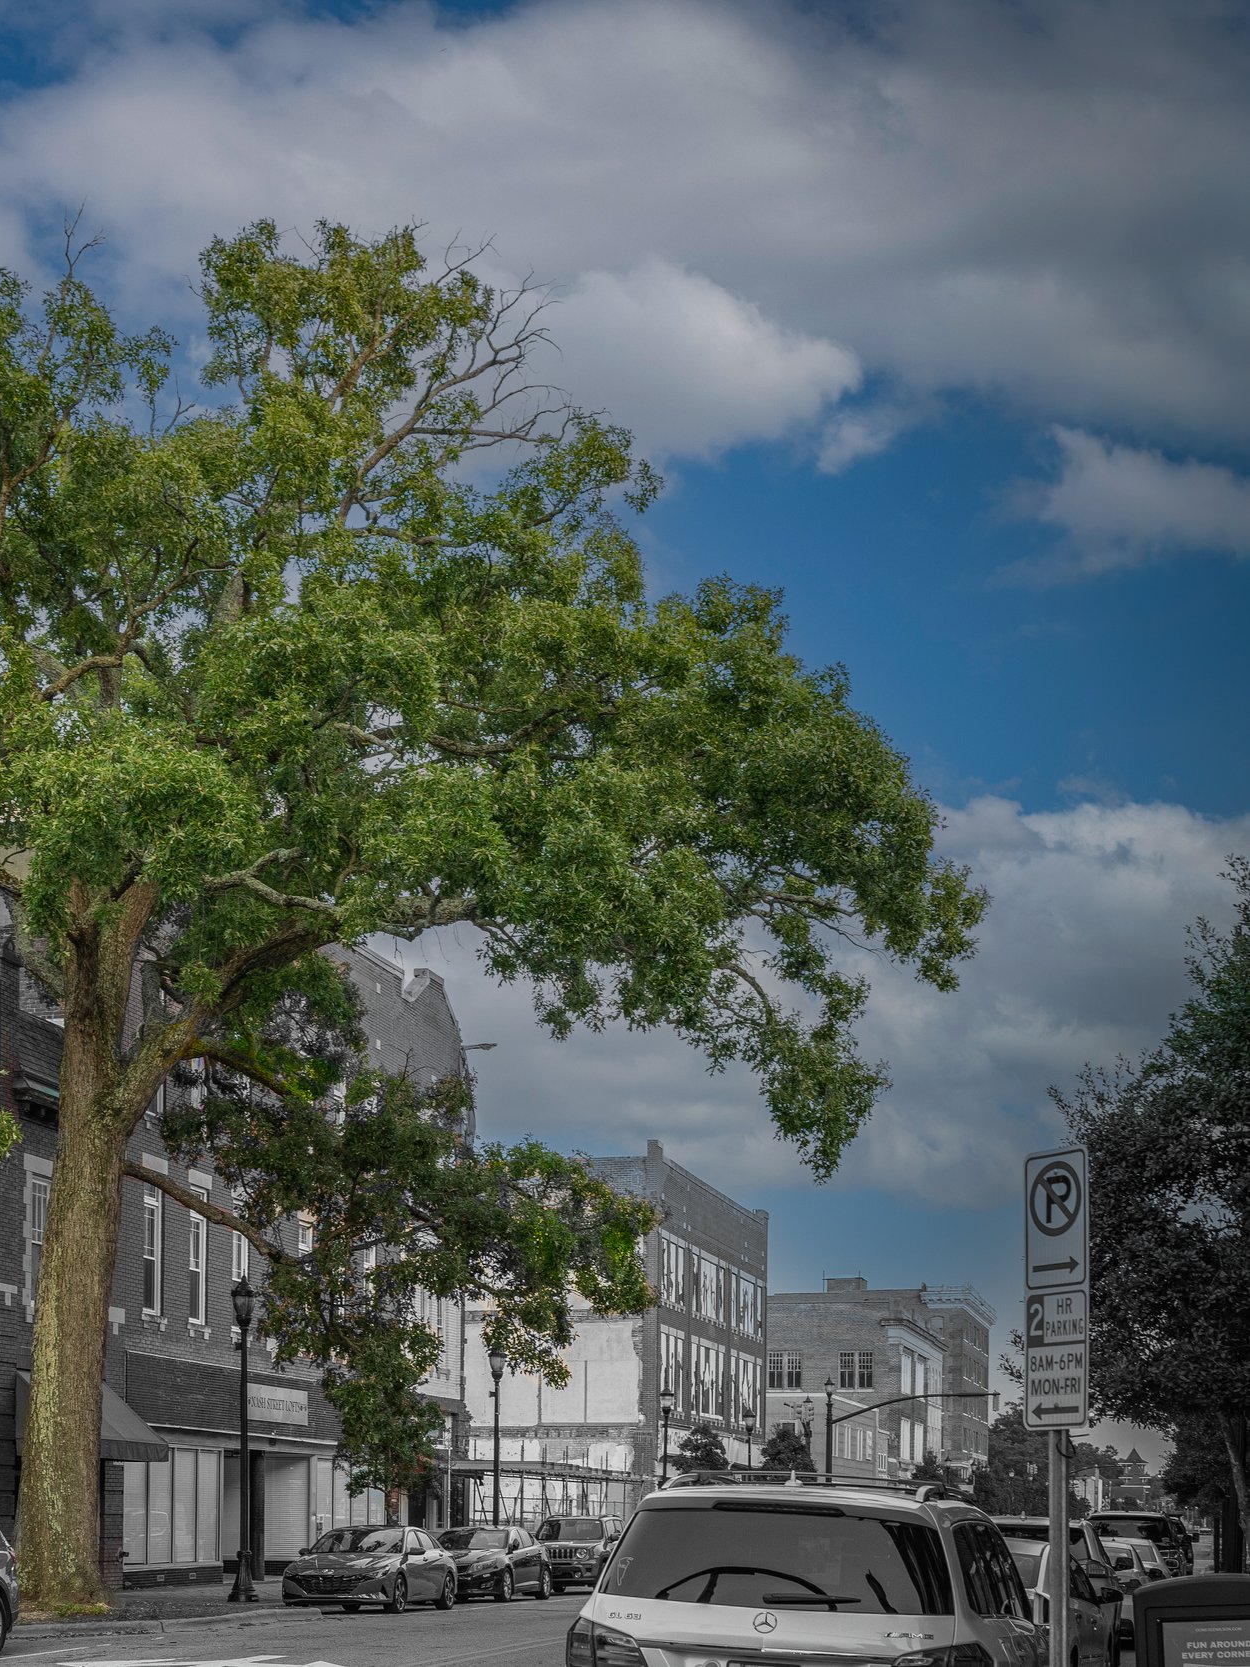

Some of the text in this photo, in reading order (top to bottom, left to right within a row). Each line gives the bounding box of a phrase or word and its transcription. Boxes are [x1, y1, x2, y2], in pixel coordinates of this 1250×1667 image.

[1056, 1298, 1073, 1315] HR
[1029, 1303, 1044, 1337] 2
[1045, 1319, 1084, 1337] PARKING
[1030, 1353, 1083, 1372] 8AM-6PM
[1030, 1376, 1081, 1395] MON-FRI
[250, 1396, 266, 1409] NASH
[267, 1398, 284, 1411] STREET
[1187, 1640, 1250, 1649] FUN AROUND
[1182, 1651, 1214, 1659] EVERY
